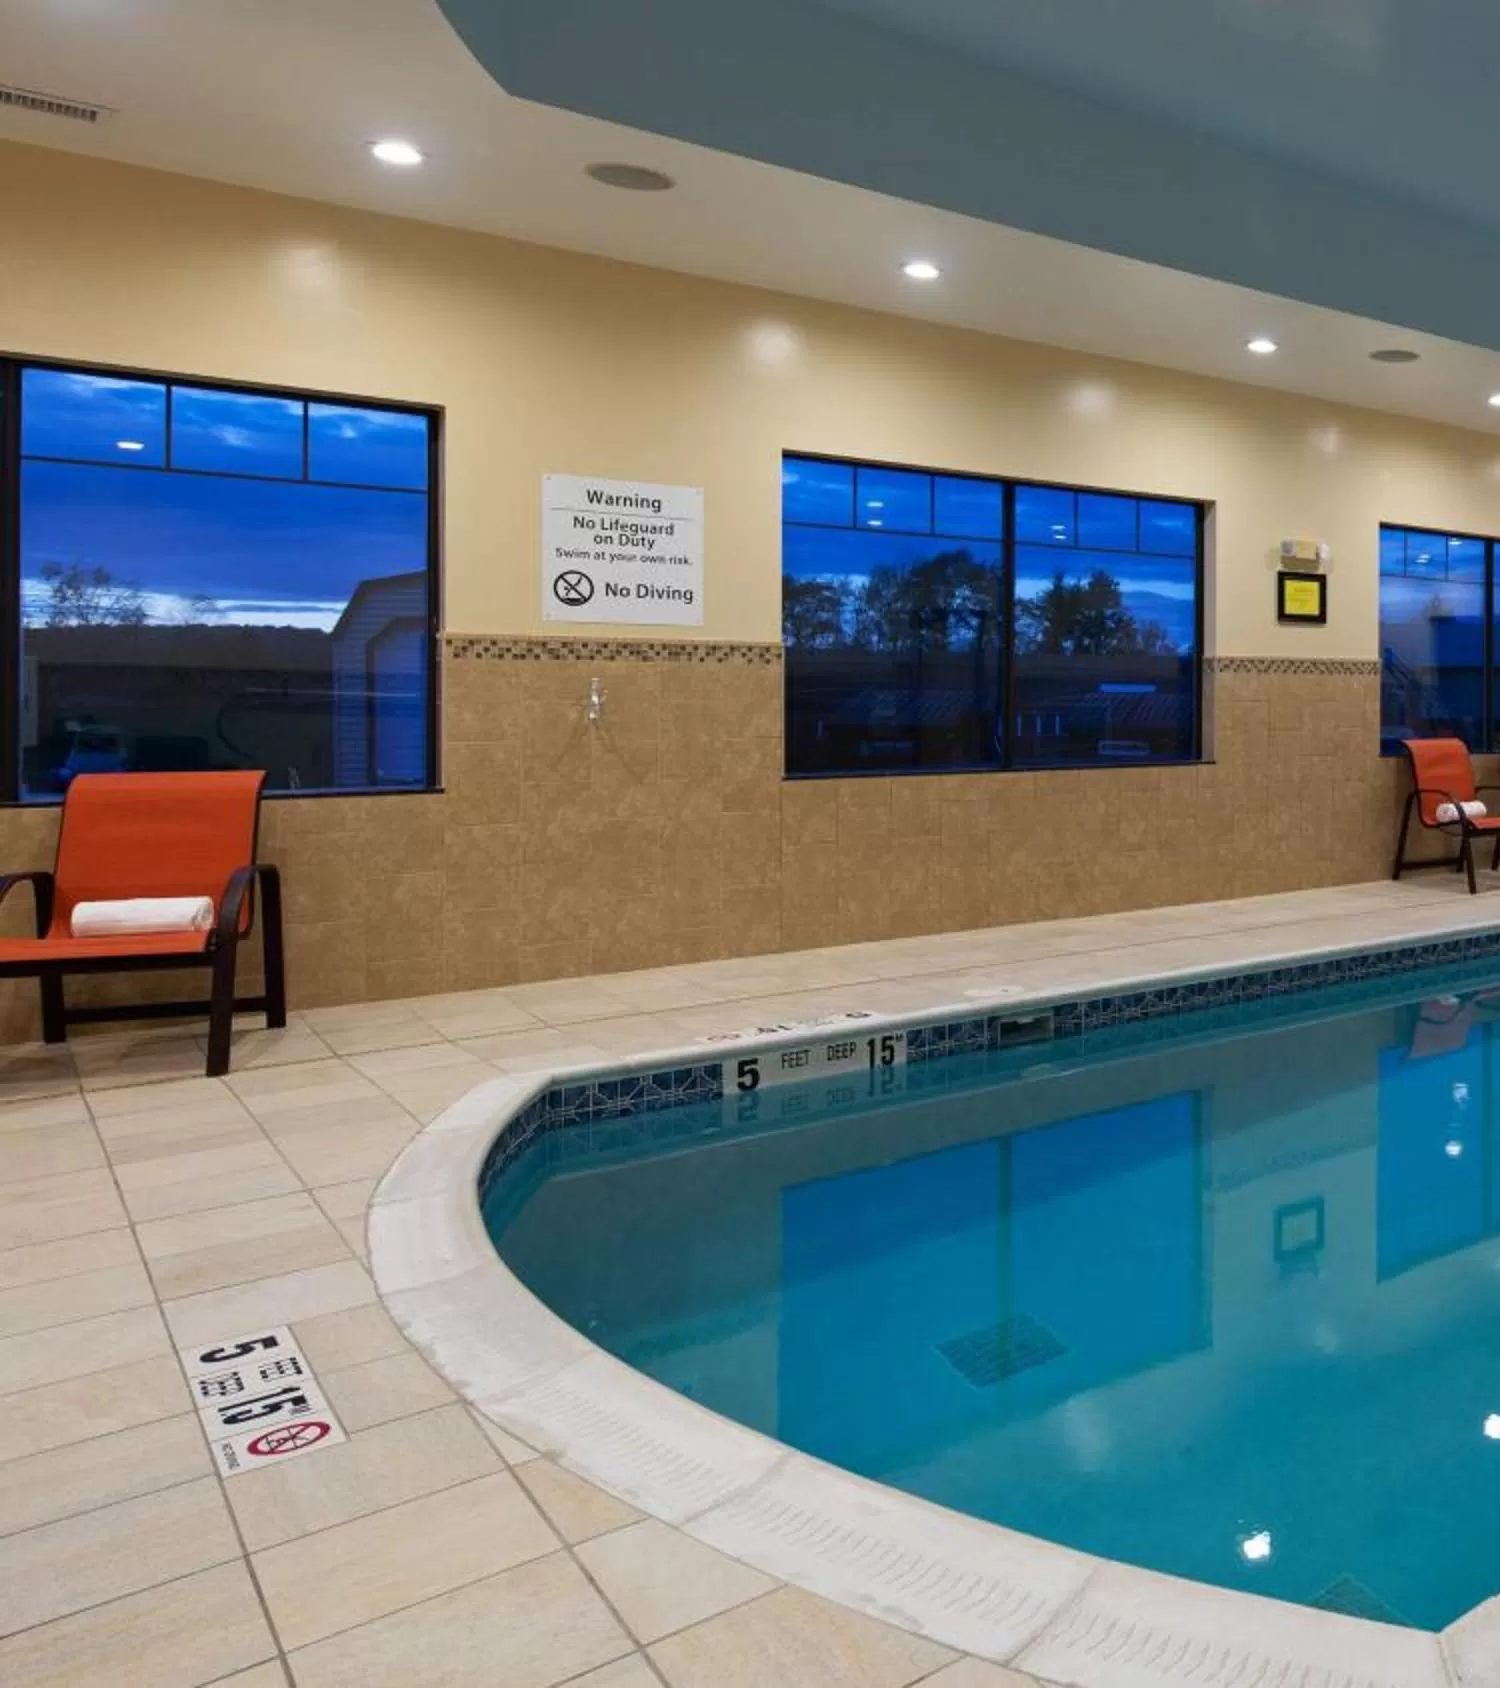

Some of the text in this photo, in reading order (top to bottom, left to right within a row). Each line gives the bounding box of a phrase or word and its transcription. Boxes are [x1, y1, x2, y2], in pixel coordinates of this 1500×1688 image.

[586, 489, 662, 513] Warning
[573, 516, 675, 536] No Lifeguard
[593, 533, 655, 550] on Duty
[555, 547, 590, 560] Swim
[593, 550, 606, 560] at
[609, 553, 637, 564] your
[640, 555, 666, 564] own
[605, 582, 693, 604] No Diving
[737, 1057, 760, 1091] 5
[781, 1049, 811, 1070] FEET
[827, 1041, 857, 1062] DEEP
[200, 1335, 279, 1362] 5
